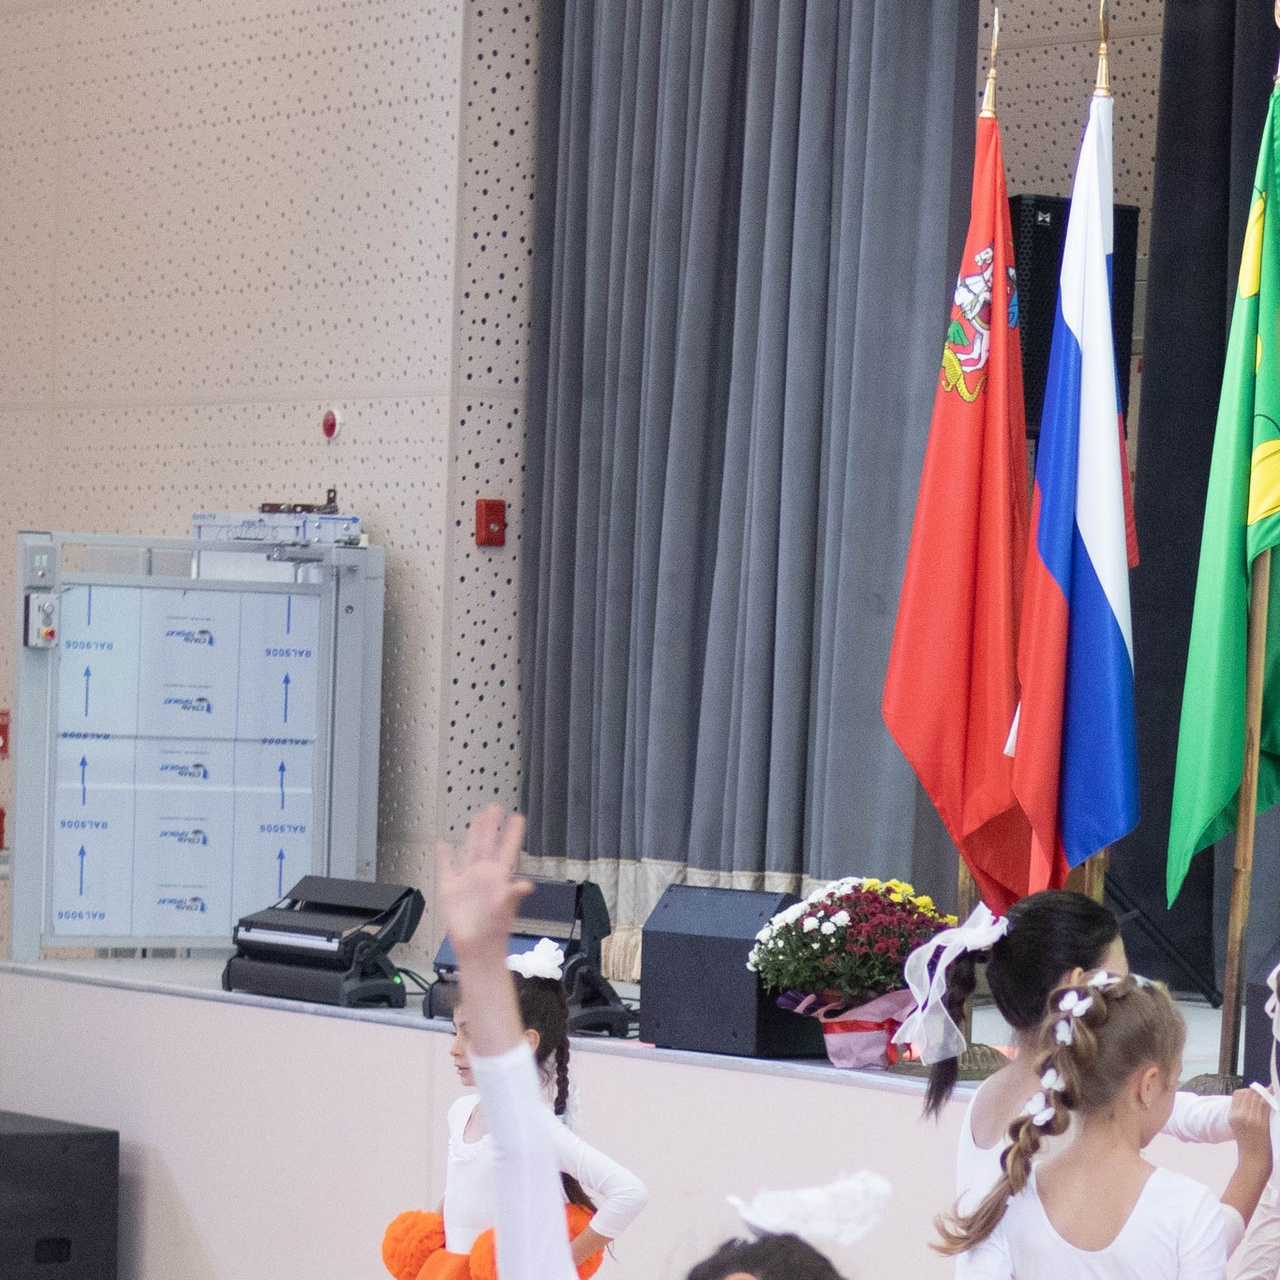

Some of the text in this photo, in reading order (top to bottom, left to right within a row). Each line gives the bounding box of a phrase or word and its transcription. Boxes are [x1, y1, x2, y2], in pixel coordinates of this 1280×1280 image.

[65, 640, 114, 651] RAL9006
[265, 648, 312, 658] RAL9006
[60, 820, 108, 830] RAL9006
[260, 824, 306, 833] RAL9006
[58, 910, 106, 920] RAL9006
